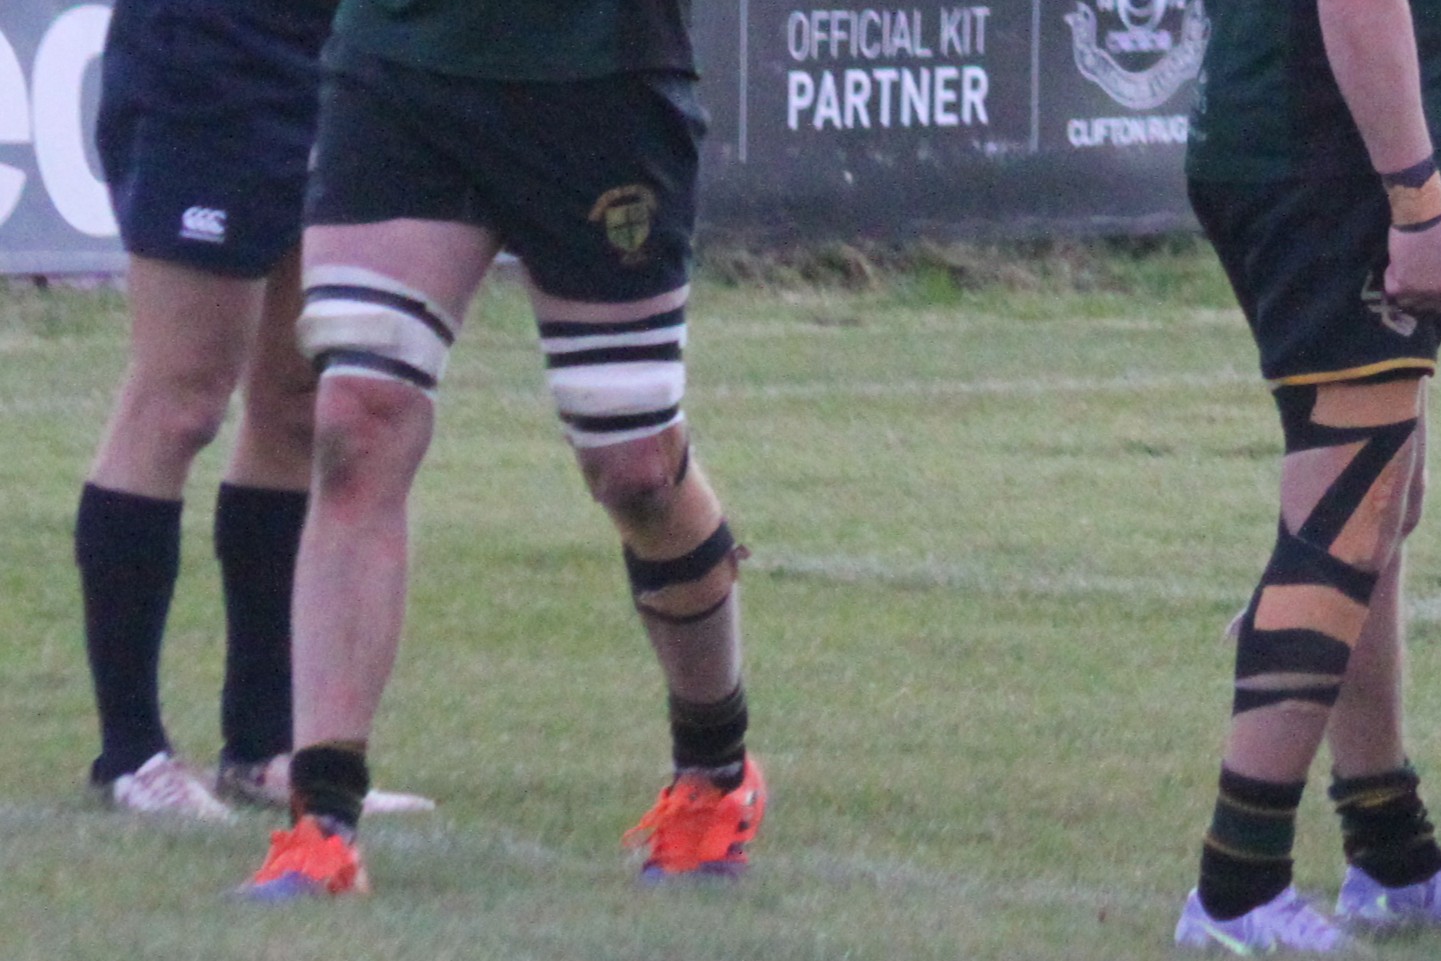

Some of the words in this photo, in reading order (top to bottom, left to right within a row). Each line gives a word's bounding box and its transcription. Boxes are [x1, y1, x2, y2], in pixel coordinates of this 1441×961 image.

[787, 7, 933, 60] OFFICIAL
[940, 5, 993, 57] KIT
[787, 66, 989, 131] PARTNER
[1149, 114, 1189, 144] RUG
